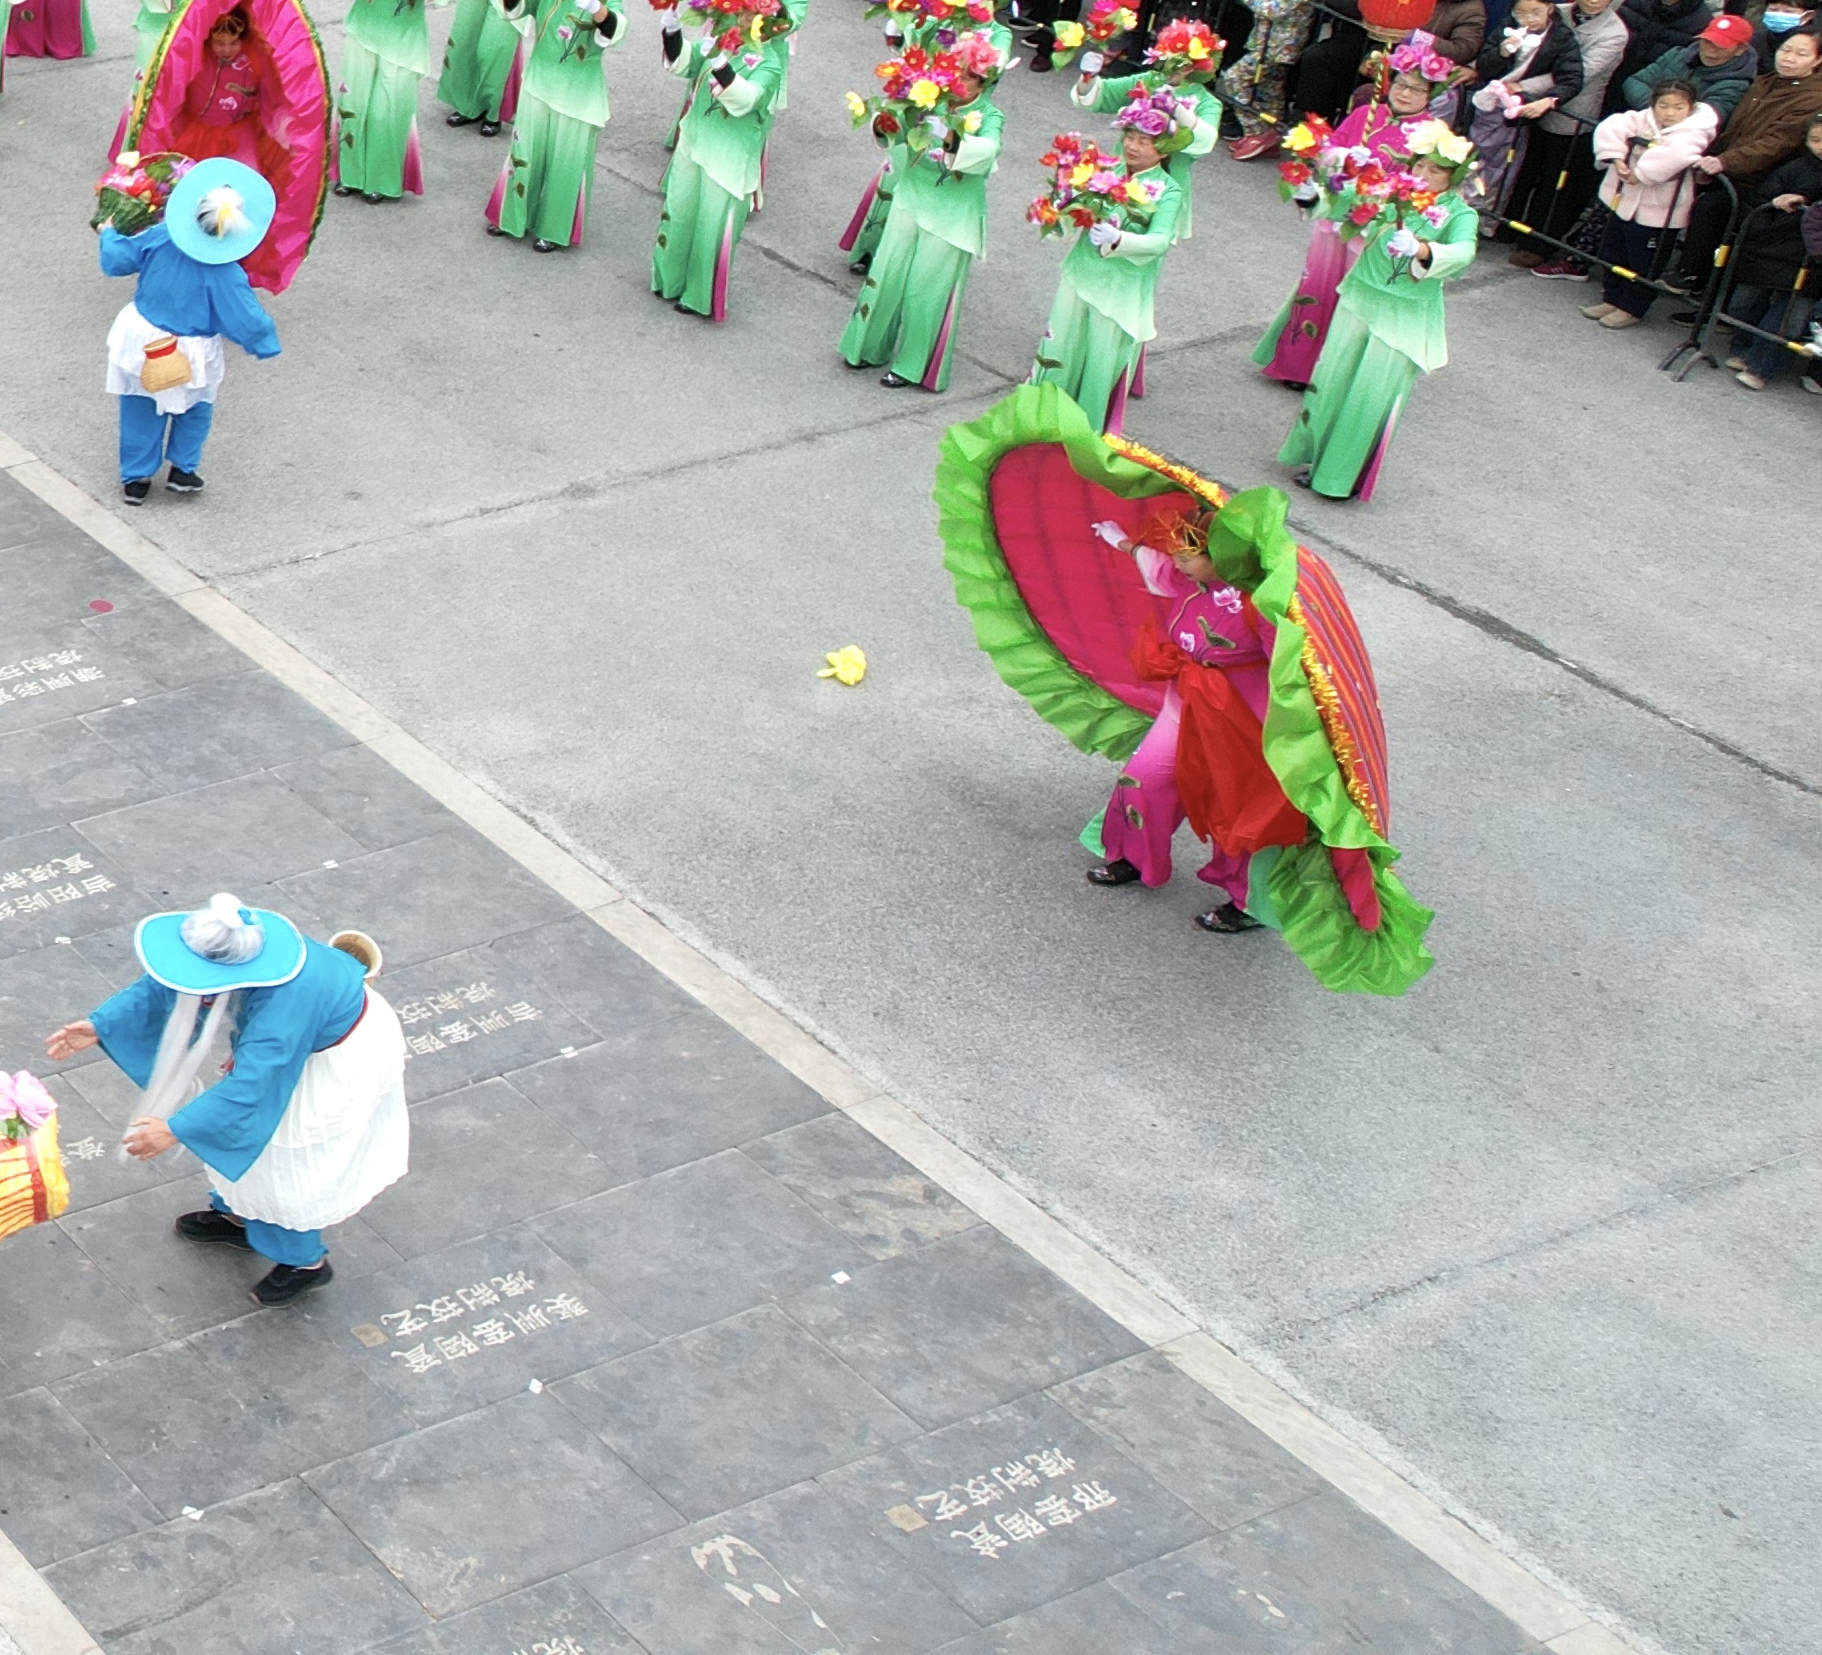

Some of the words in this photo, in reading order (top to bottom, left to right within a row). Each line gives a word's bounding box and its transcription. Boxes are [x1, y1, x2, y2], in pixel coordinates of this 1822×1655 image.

[396, 981, 497, 1026] 烧制技
[403, 1000, 544, 1060] 吉州窑陶
[380, 1270, 536, 1338] 烧制技艺
[915, 1446, 1077, 1522] 烧制技艺
